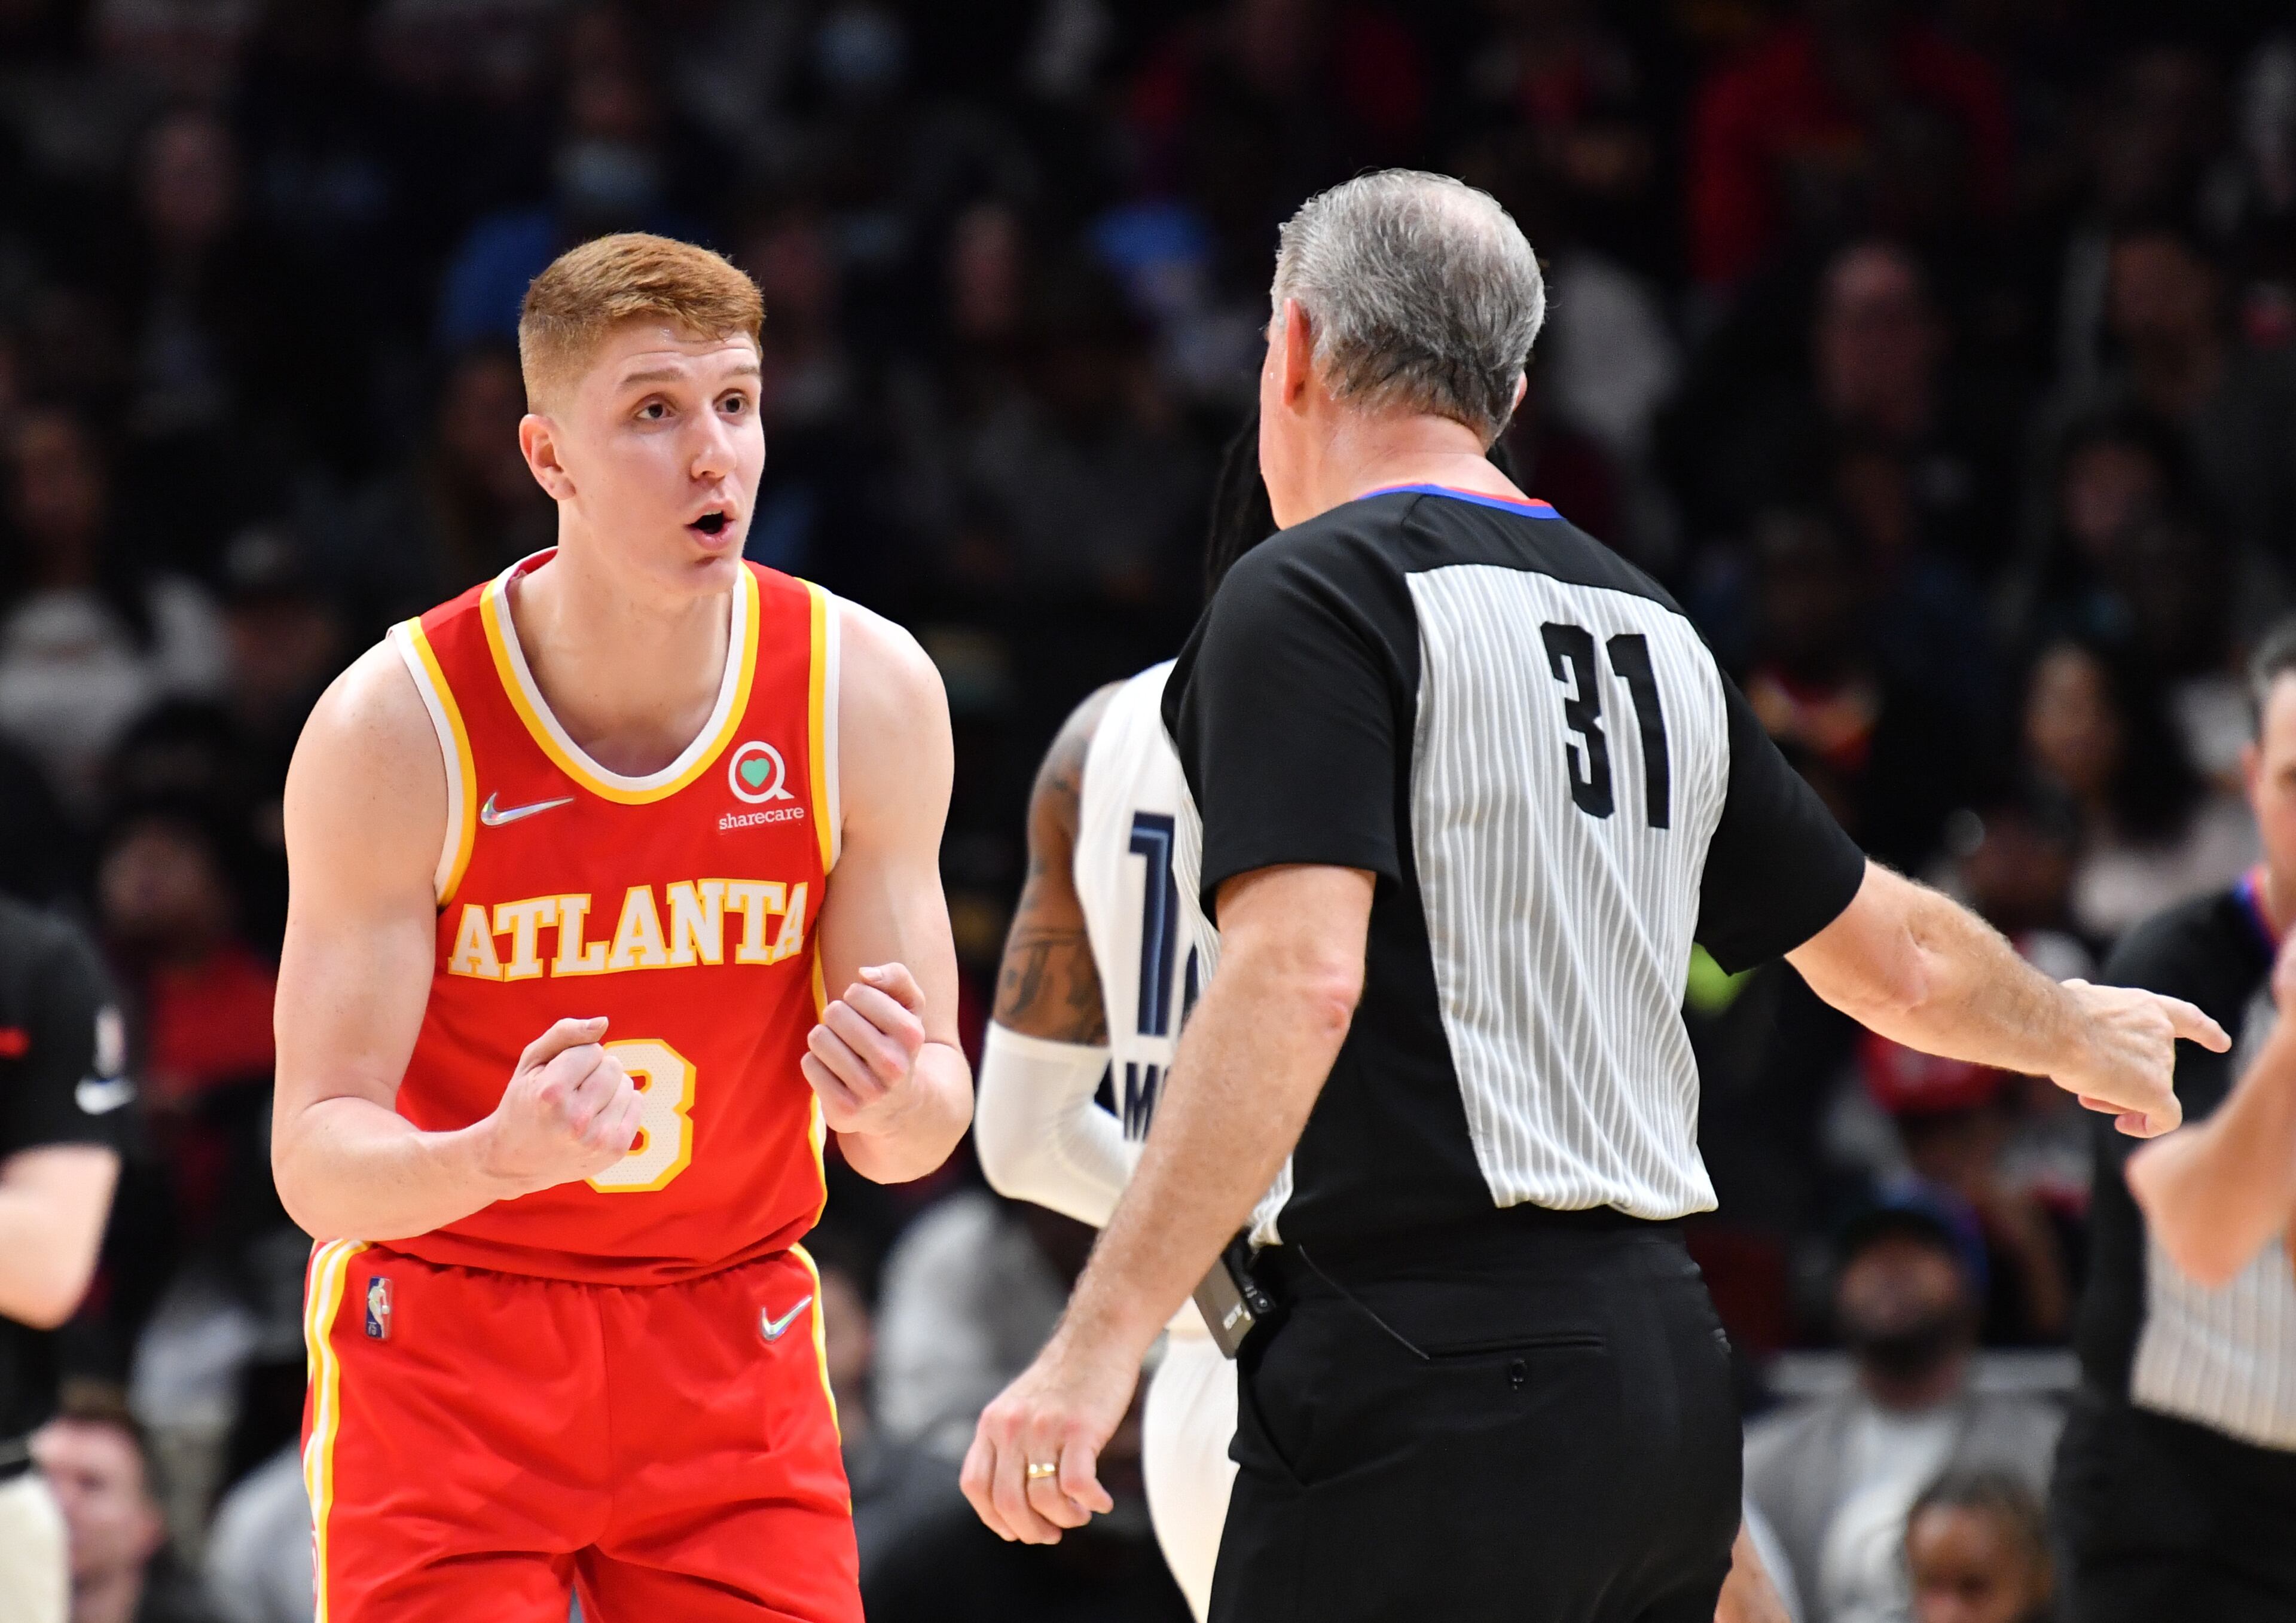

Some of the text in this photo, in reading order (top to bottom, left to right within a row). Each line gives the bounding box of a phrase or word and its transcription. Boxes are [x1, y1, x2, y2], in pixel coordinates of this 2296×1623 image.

[1540, 621, 1669, 829] 31
[719, 807, 804, 830] sharecare
[448, 878, 808, 982] ATLANTA
